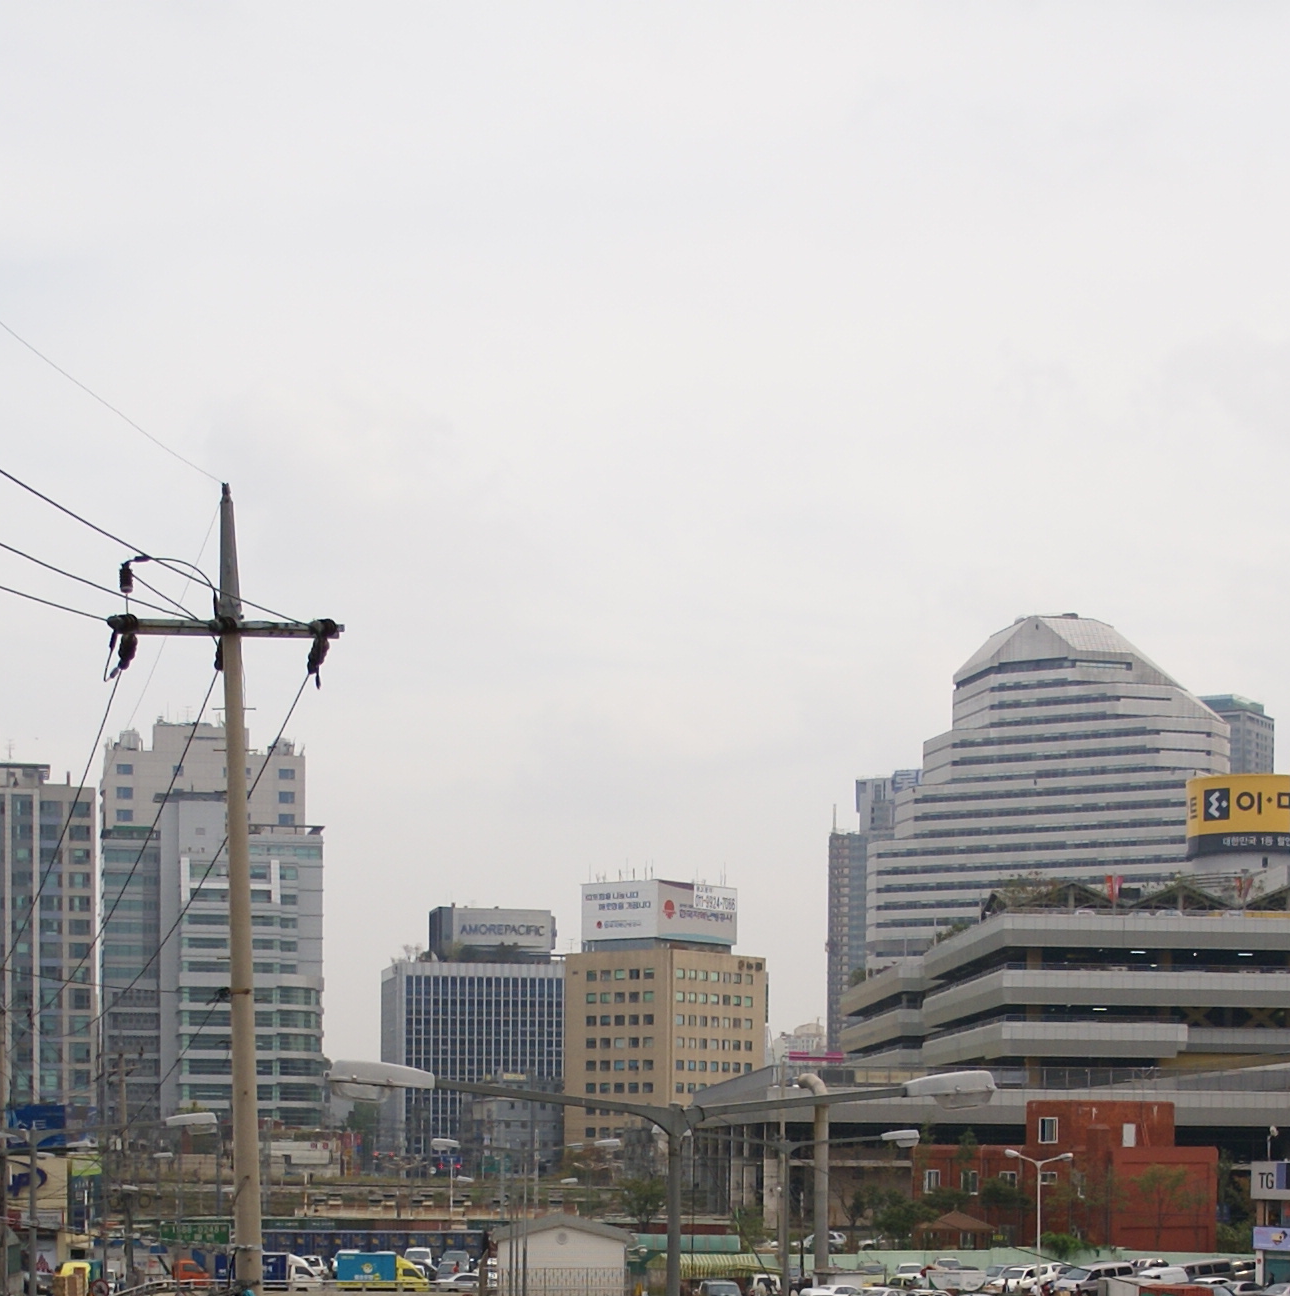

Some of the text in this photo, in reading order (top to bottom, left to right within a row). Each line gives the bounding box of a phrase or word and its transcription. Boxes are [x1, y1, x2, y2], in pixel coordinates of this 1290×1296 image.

[1222, 836, 1257, 847] 대한민국
[1261, 836, 1274, 847] 1등
[459, 921, 546, 938] AMOREPACIFIC
[1259, 1172, 1274, 1190] TG
